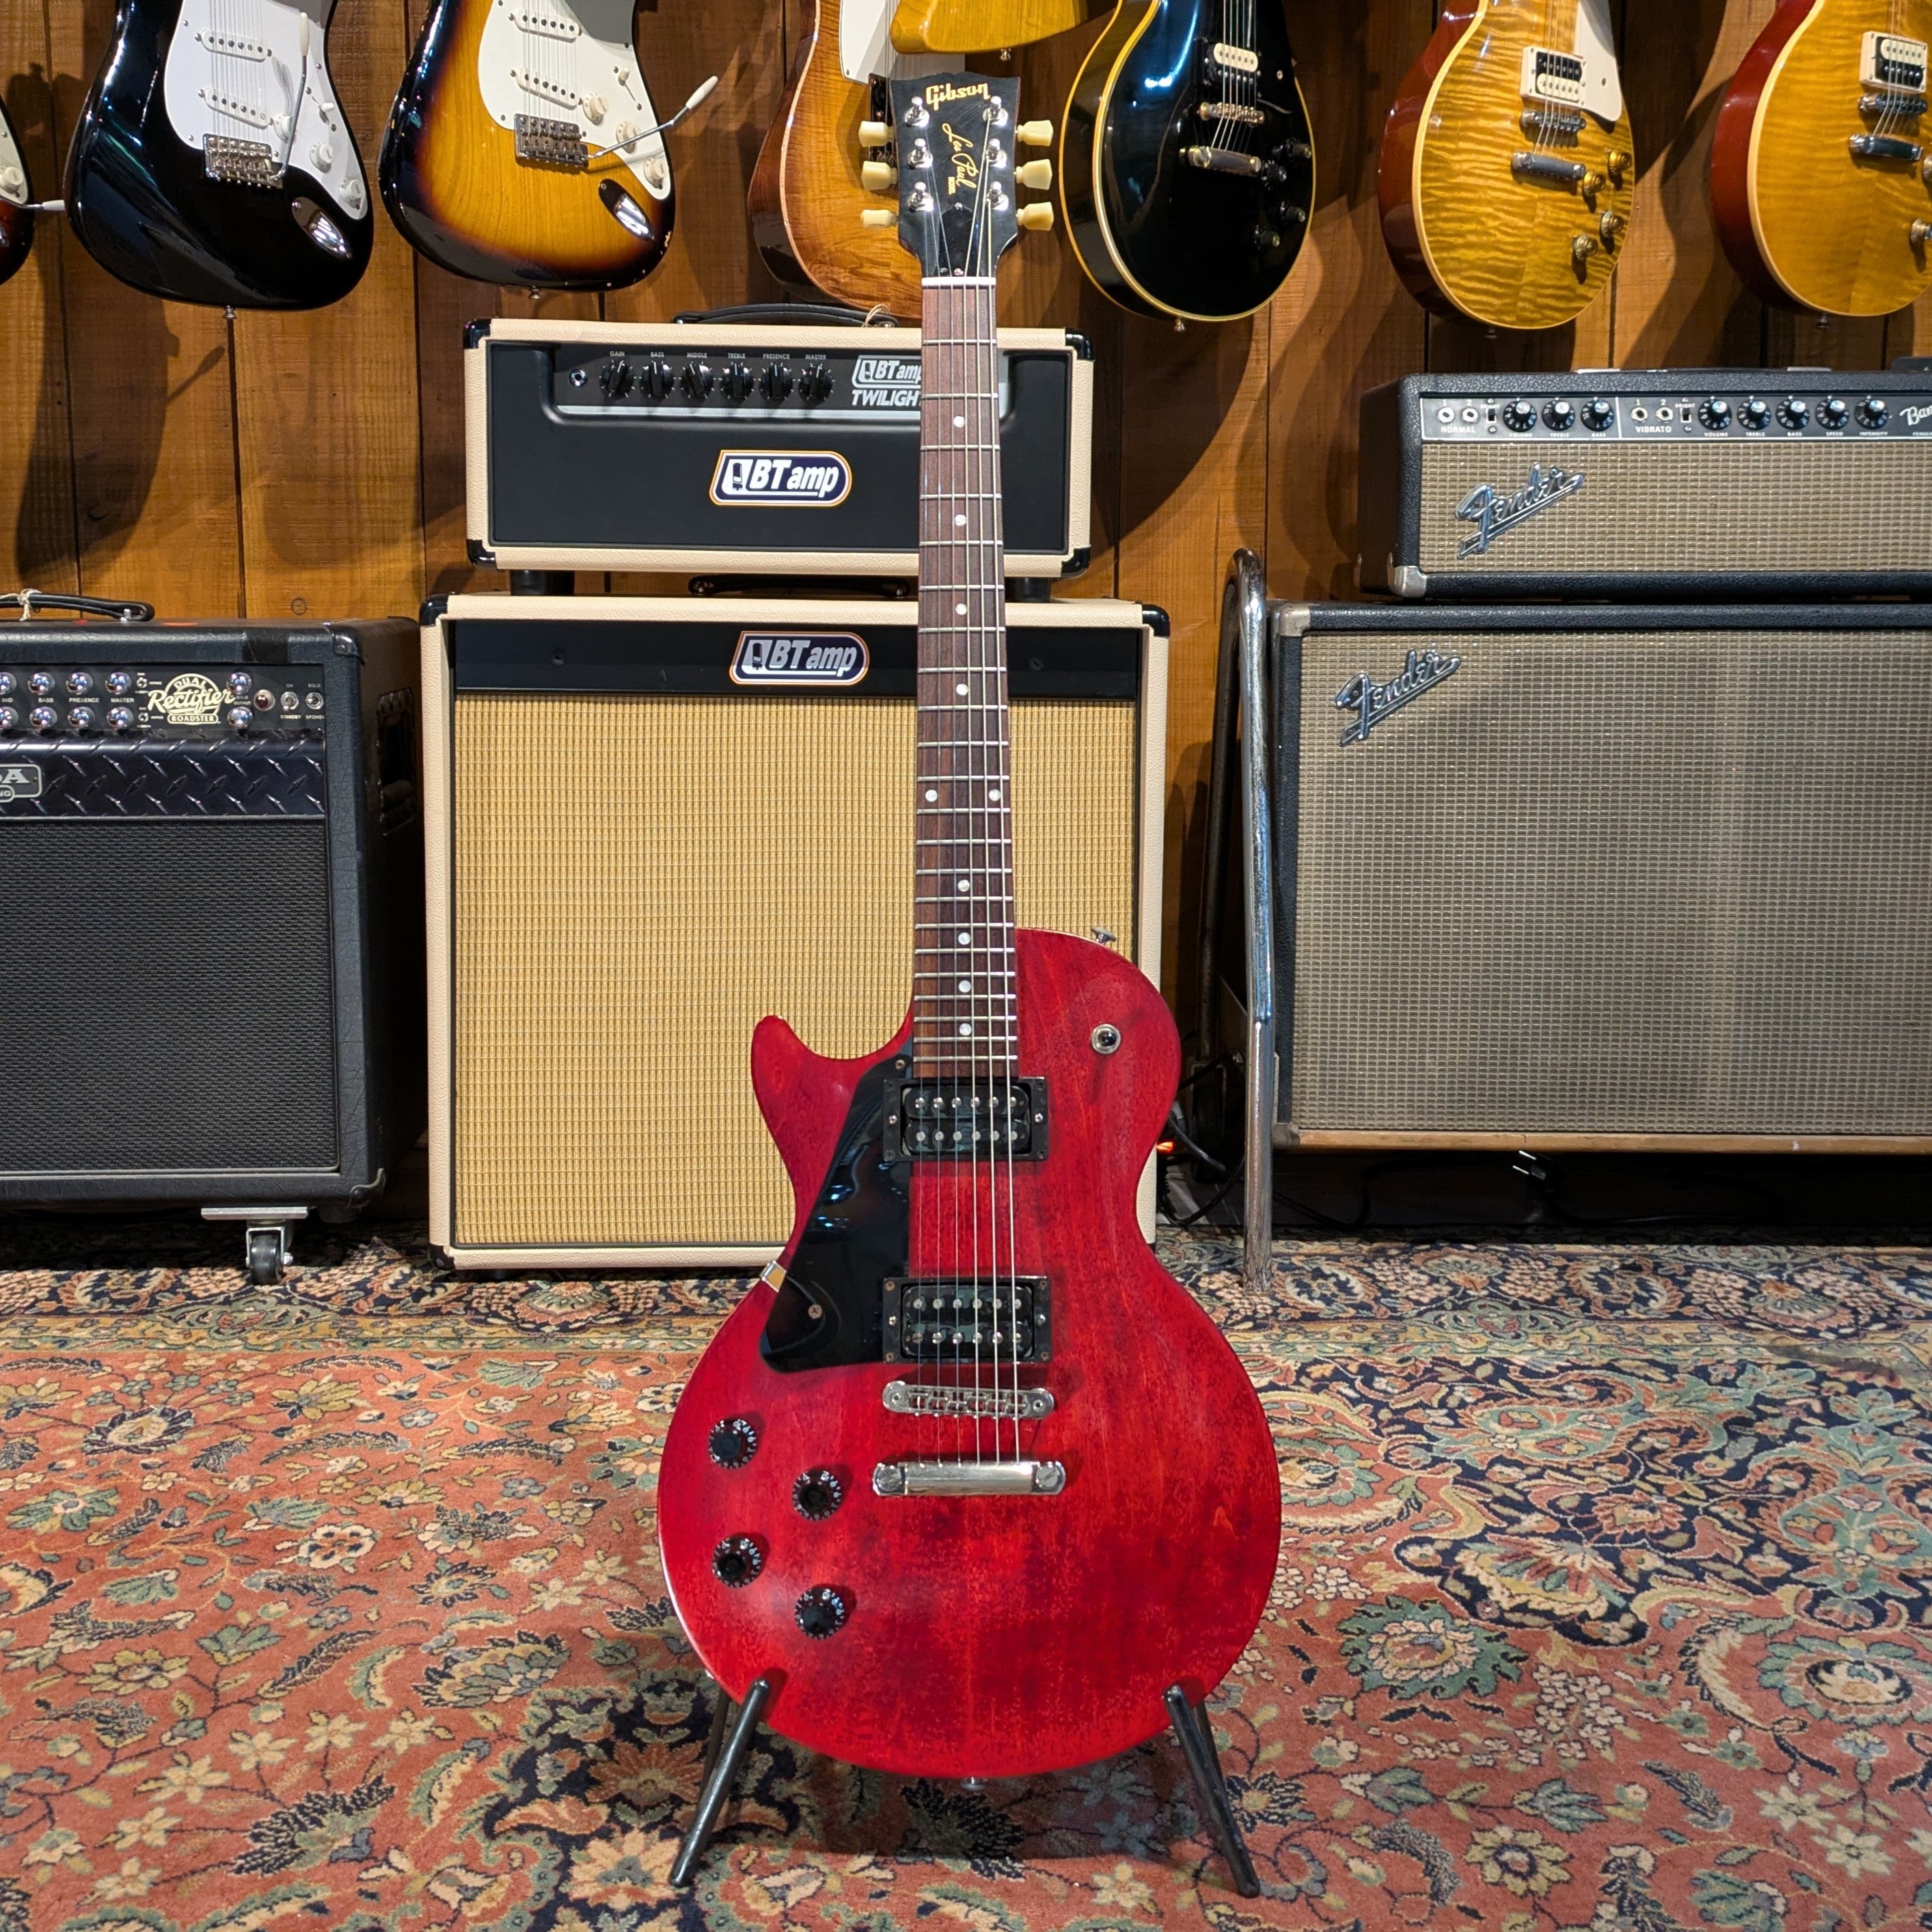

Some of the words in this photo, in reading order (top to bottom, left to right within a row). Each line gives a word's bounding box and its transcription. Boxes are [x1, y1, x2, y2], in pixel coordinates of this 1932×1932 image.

[926, 83, 991, 111] Gibson
[942, 123, 974, 152] Les
[951, 153, 979, 188] Paul
[787, 465, 839, 498] amp
[1455, 462, 1584, 559] Fender
[806, 646, 856, 677] amp
[174, 677, 206, 690] DUAL
[1335, 649, 1461, 746] Fender
[148, 688, 236, 714] Rectifier
[0, 769, 30, 783] A
